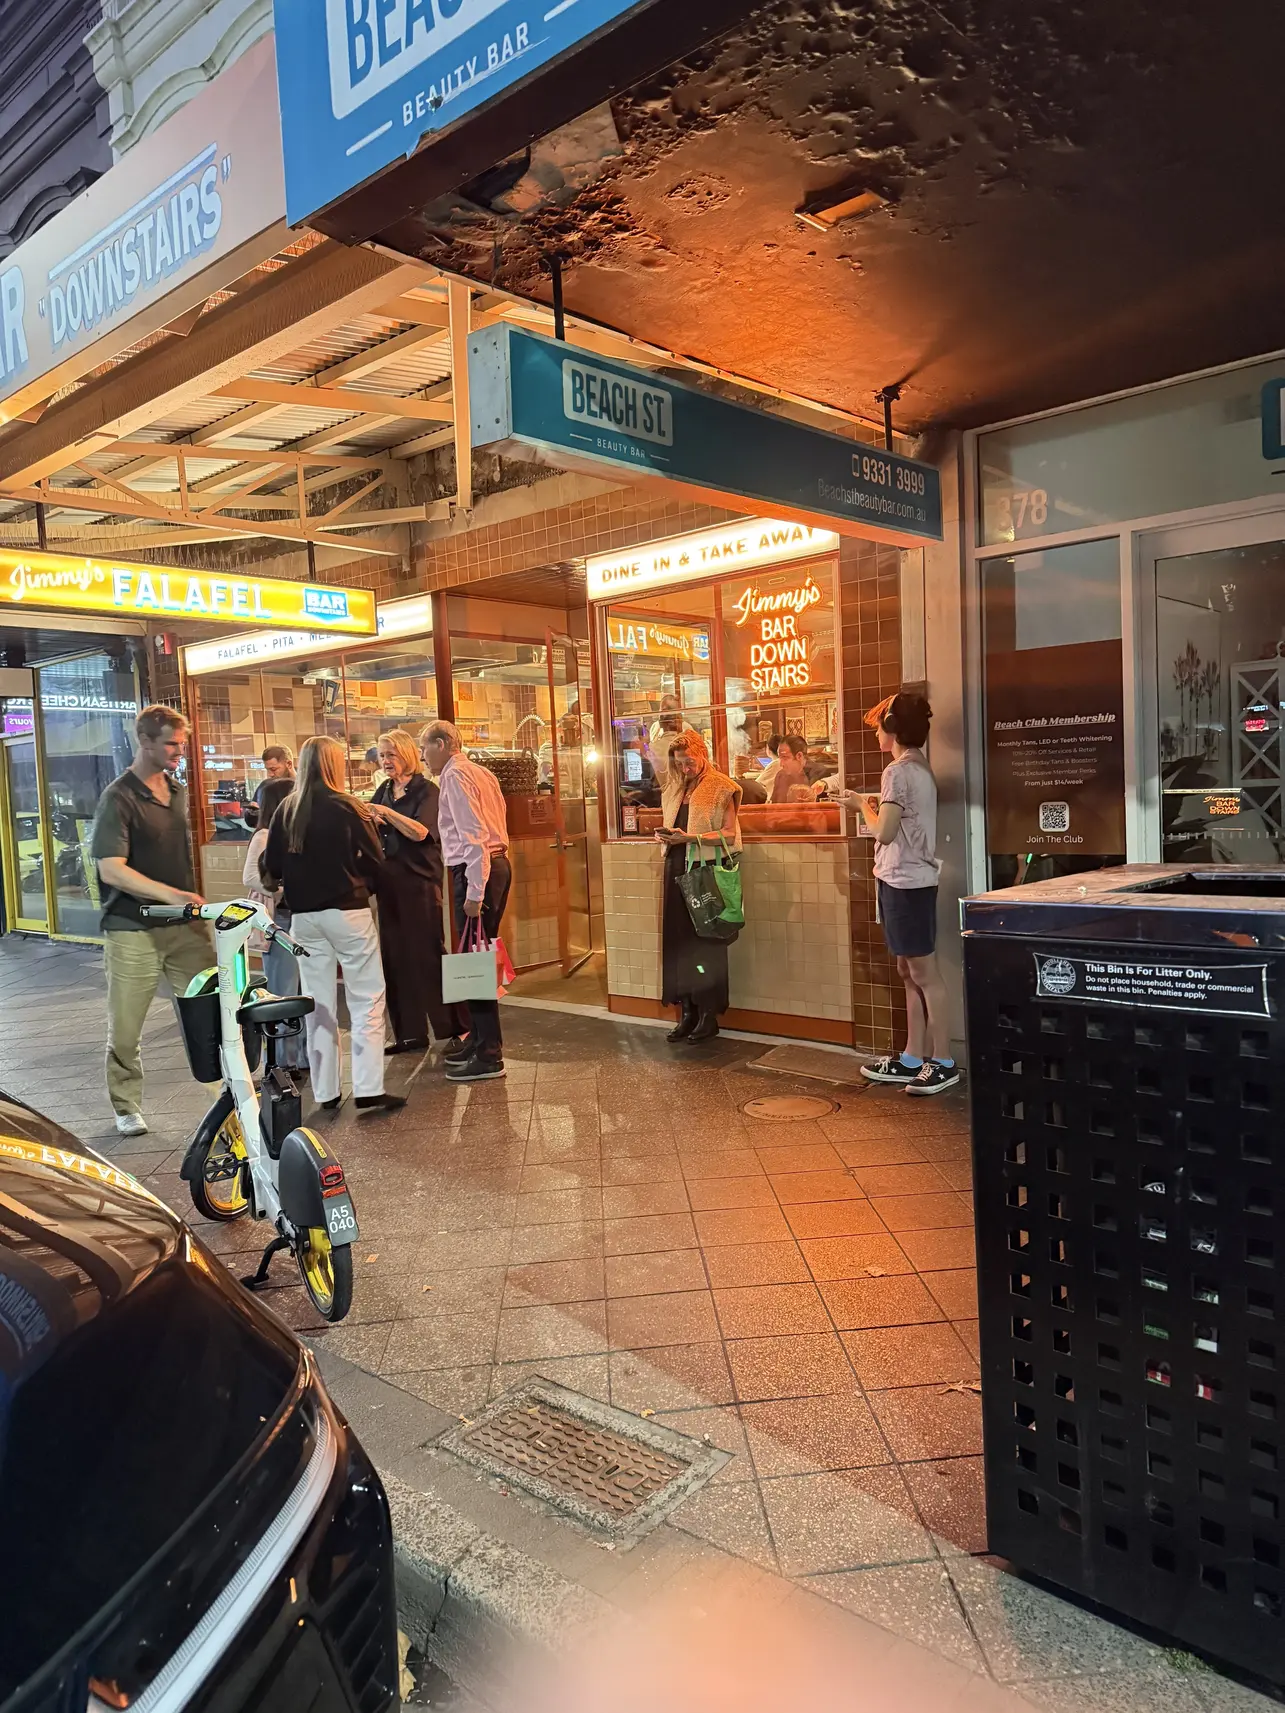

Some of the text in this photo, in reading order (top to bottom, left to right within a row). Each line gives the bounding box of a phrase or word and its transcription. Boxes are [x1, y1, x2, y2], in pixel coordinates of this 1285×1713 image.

[486, 22, 529, 70] BAR
[571, 368, 666, 437] BEACH ST.
[597, 438, 646, 458] BEAUTY BAR
[862, 456, 925, 496] 9331 3999
[817, 478, 926, 522] Beachstbeautybar.com.au
[602, 526, 814, 583] DINE IN & TAKE AWAY
[9, 560, 272, 619] Jimmy's FALAFEL
[306, 592, 346, 610] BAR
[732, 577, 821, 625] Jimmy's
[761, 615, 797, 641] BAR
[217, 643, 259, 659] FALAFEL
[272, 636, 294, 649] PITA
[750, 638, 807, 666] DOWN
[750, 662, 809, 690] STAIRS
[994, 712, 1116, 730] Beach Club Membership
[1079, 734, 1113, 742] Whitening
[1054, 778, 1084, 786] $14/week
[1026, 834, 1084, 844] Join The Club
[1085, 963, 1213, 981] This Bin Is For Litter Only.
[1085, 975, 1096, 983] Do
[1097, 976, 1110, 984] not
[1110, 977, 1130, 985] place
[1131, 977, 1174, 988] household,
[1175, 981, 1196, 989] trade
[1207, 984, 1254, 993] commercial
[1147, 987, 1183, 997] Penalties
[1183, 990, 1208, 1000] apply.
[331, 1205, 349, 1221] A5
[329, 1217, 355, 1234] 040
